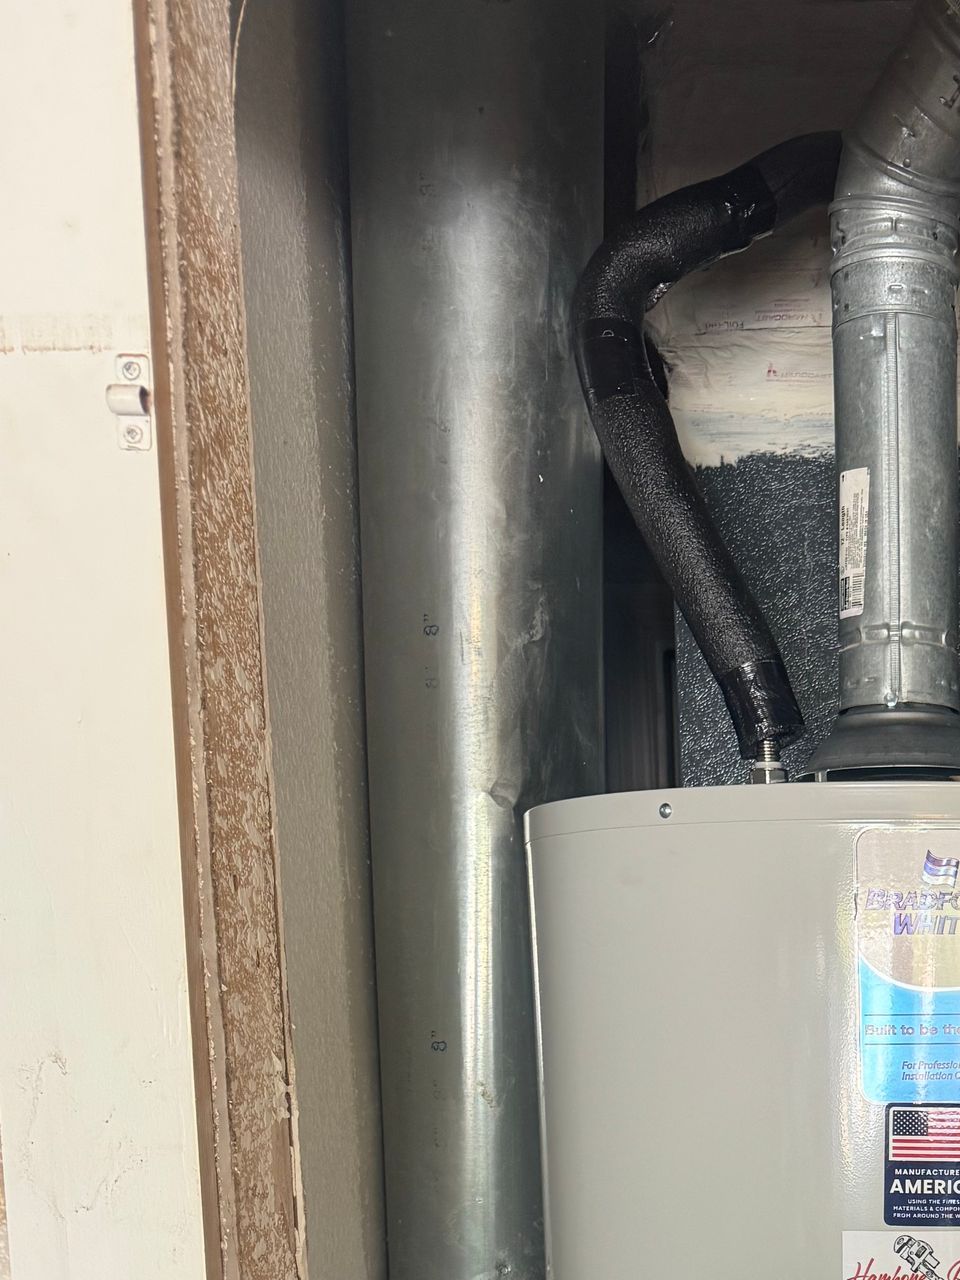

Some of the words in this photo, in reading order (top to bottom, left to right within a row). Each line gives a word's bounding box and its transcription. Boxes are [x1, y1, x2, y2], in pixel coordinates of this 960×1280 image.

[865, 1024, 897, 1035] Built
[901, 1024, 915, 1035] to
[920, 1024, 938, 1035] be
[902, 1072, 953, 1081] Installation
